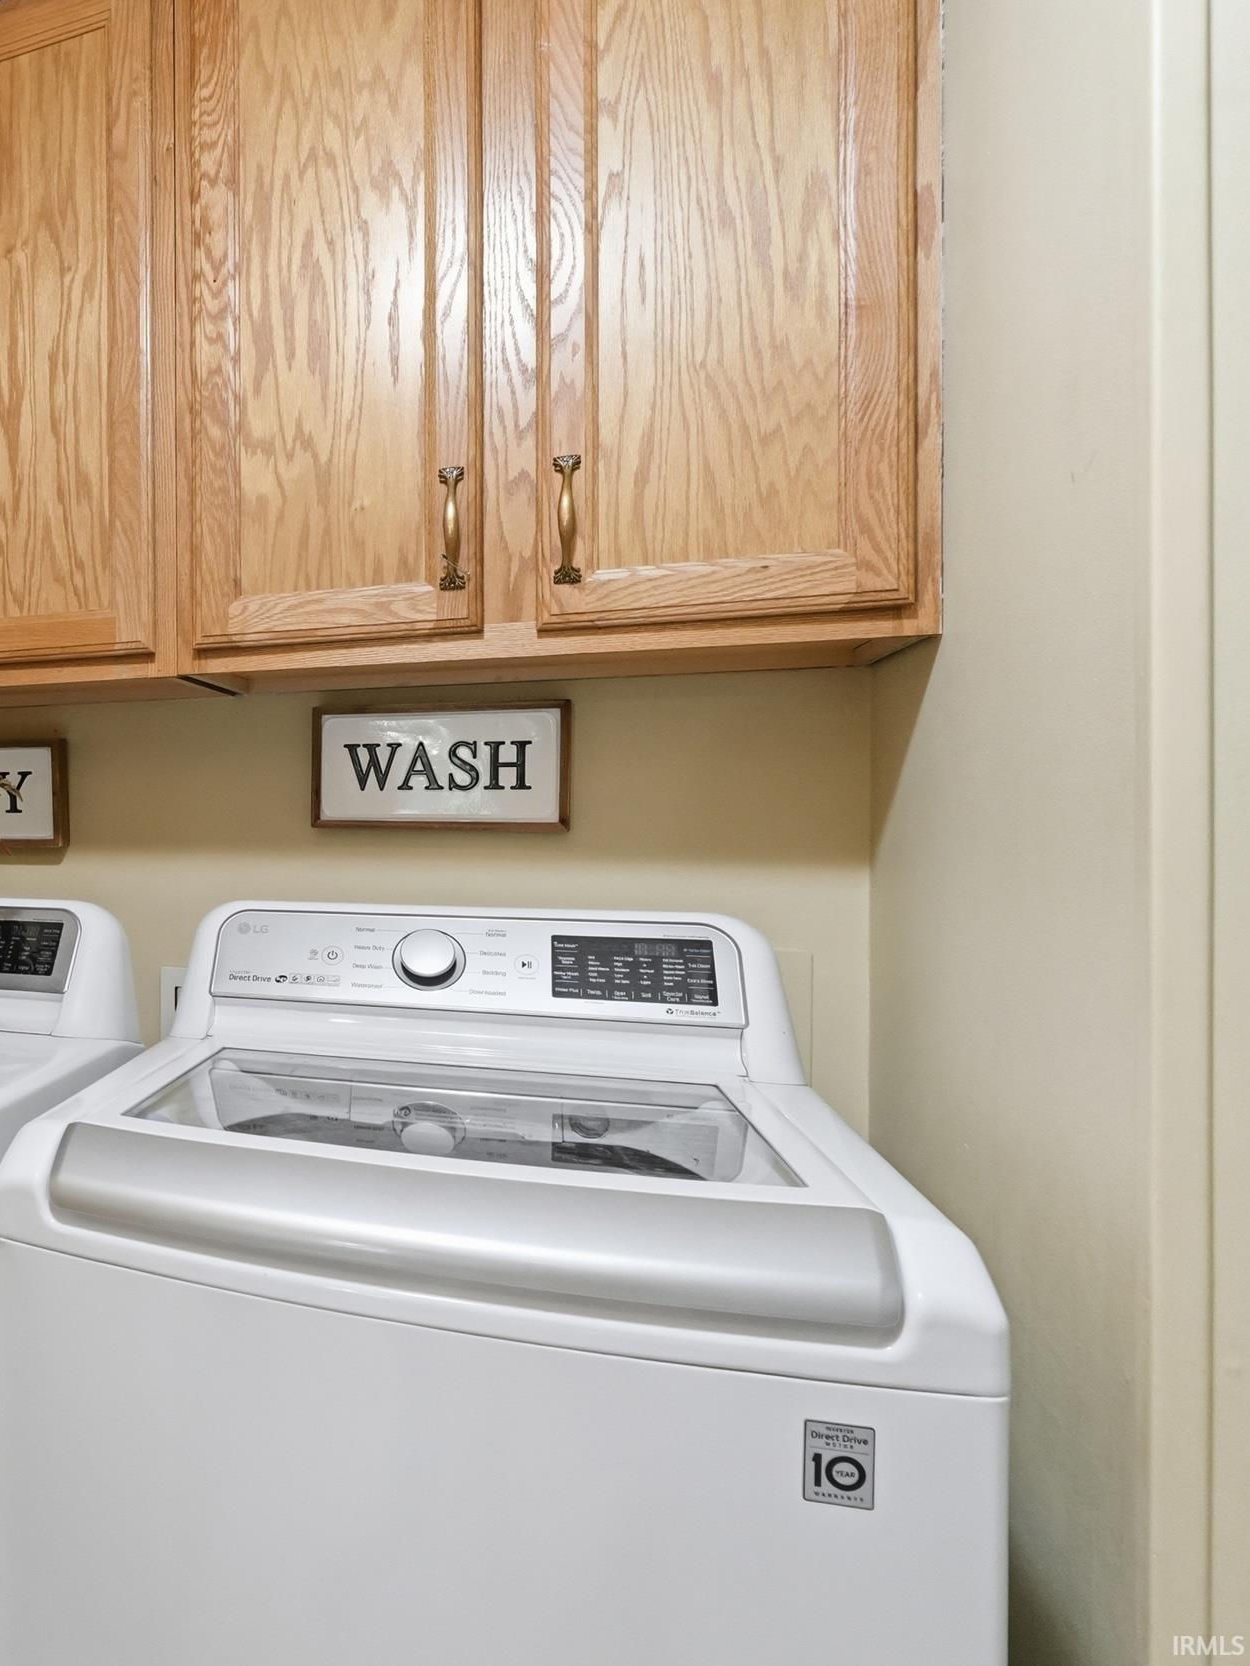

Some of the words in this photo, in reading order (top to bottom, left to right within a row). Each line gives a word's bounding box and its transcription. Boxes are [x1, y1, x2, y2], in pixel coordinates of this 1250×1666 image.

[343, 740, 532, 791] WASH
[253, 924, 269, 934] LG
[228, 973, 251, 982] Direct
[252, 974, 272, 983] Drive
[811, 1430, 840, 1442] Direct
[842, 1435, 869, 1446] Drive
[812, 1452, 866, 1492] 10
[836, 1470, 856, 1478] YEAR
